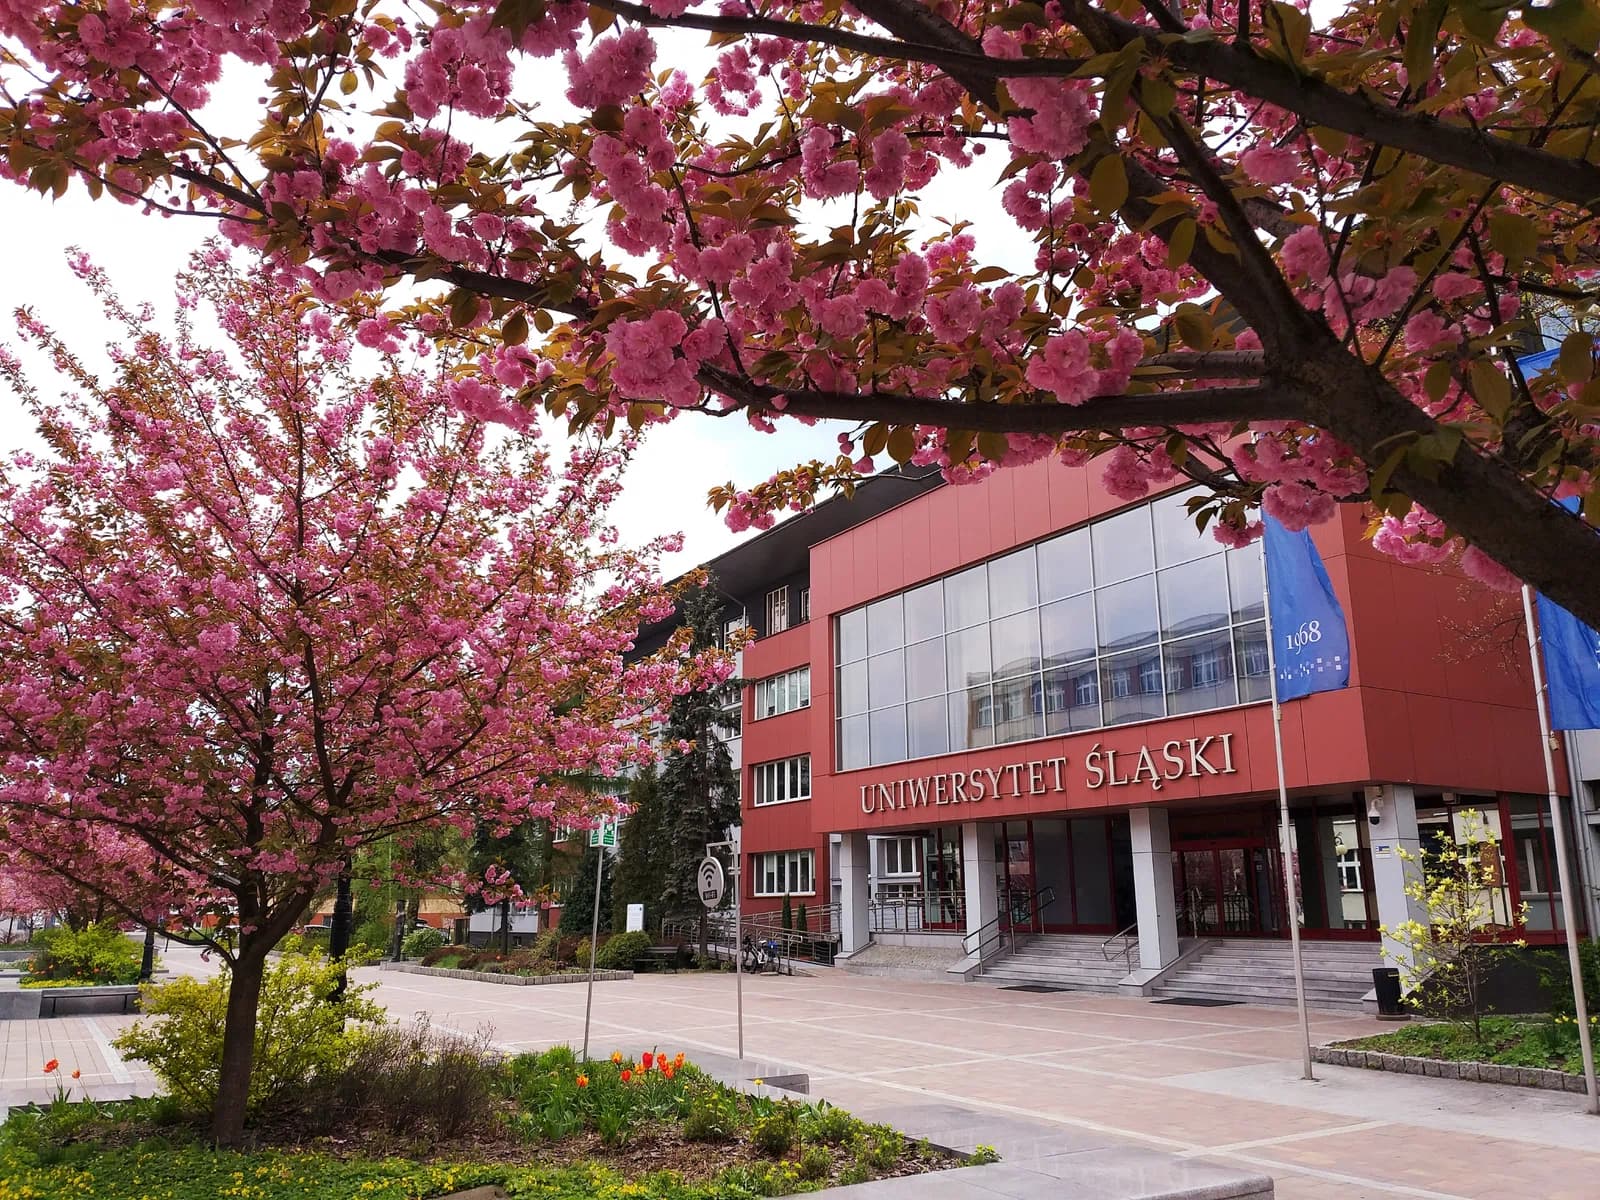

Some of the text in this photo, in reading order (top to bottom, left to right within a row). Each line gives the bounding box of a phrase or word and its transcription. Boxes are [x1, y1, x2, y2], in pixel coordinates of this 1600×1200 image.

[1286, 620, 1322, 655] 1968
[860, 733, 1237, 814] UNIWERSYTET ŚLĄSKI
